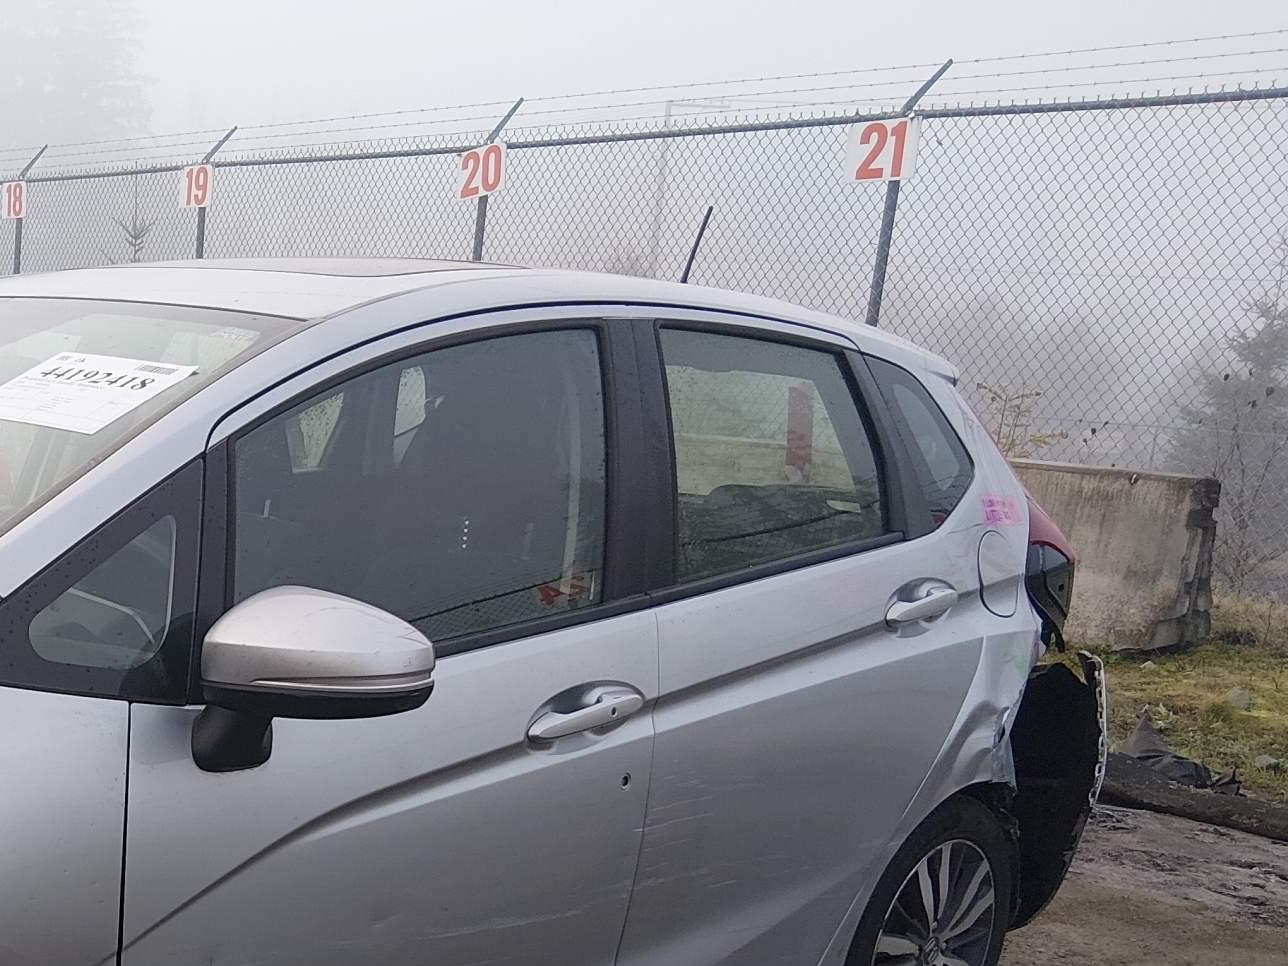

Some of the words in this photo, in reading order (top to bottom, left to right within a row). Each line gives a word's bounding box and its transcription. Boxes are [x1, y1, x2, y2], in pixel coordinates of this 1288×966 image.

[855, 120, 908, 180] 21
[185, 166, 209, 207] 19
[460, 145, 502, 199] 20
[6, 183, 23, 217] 18
[40, 365, 156, 391] 44192418
